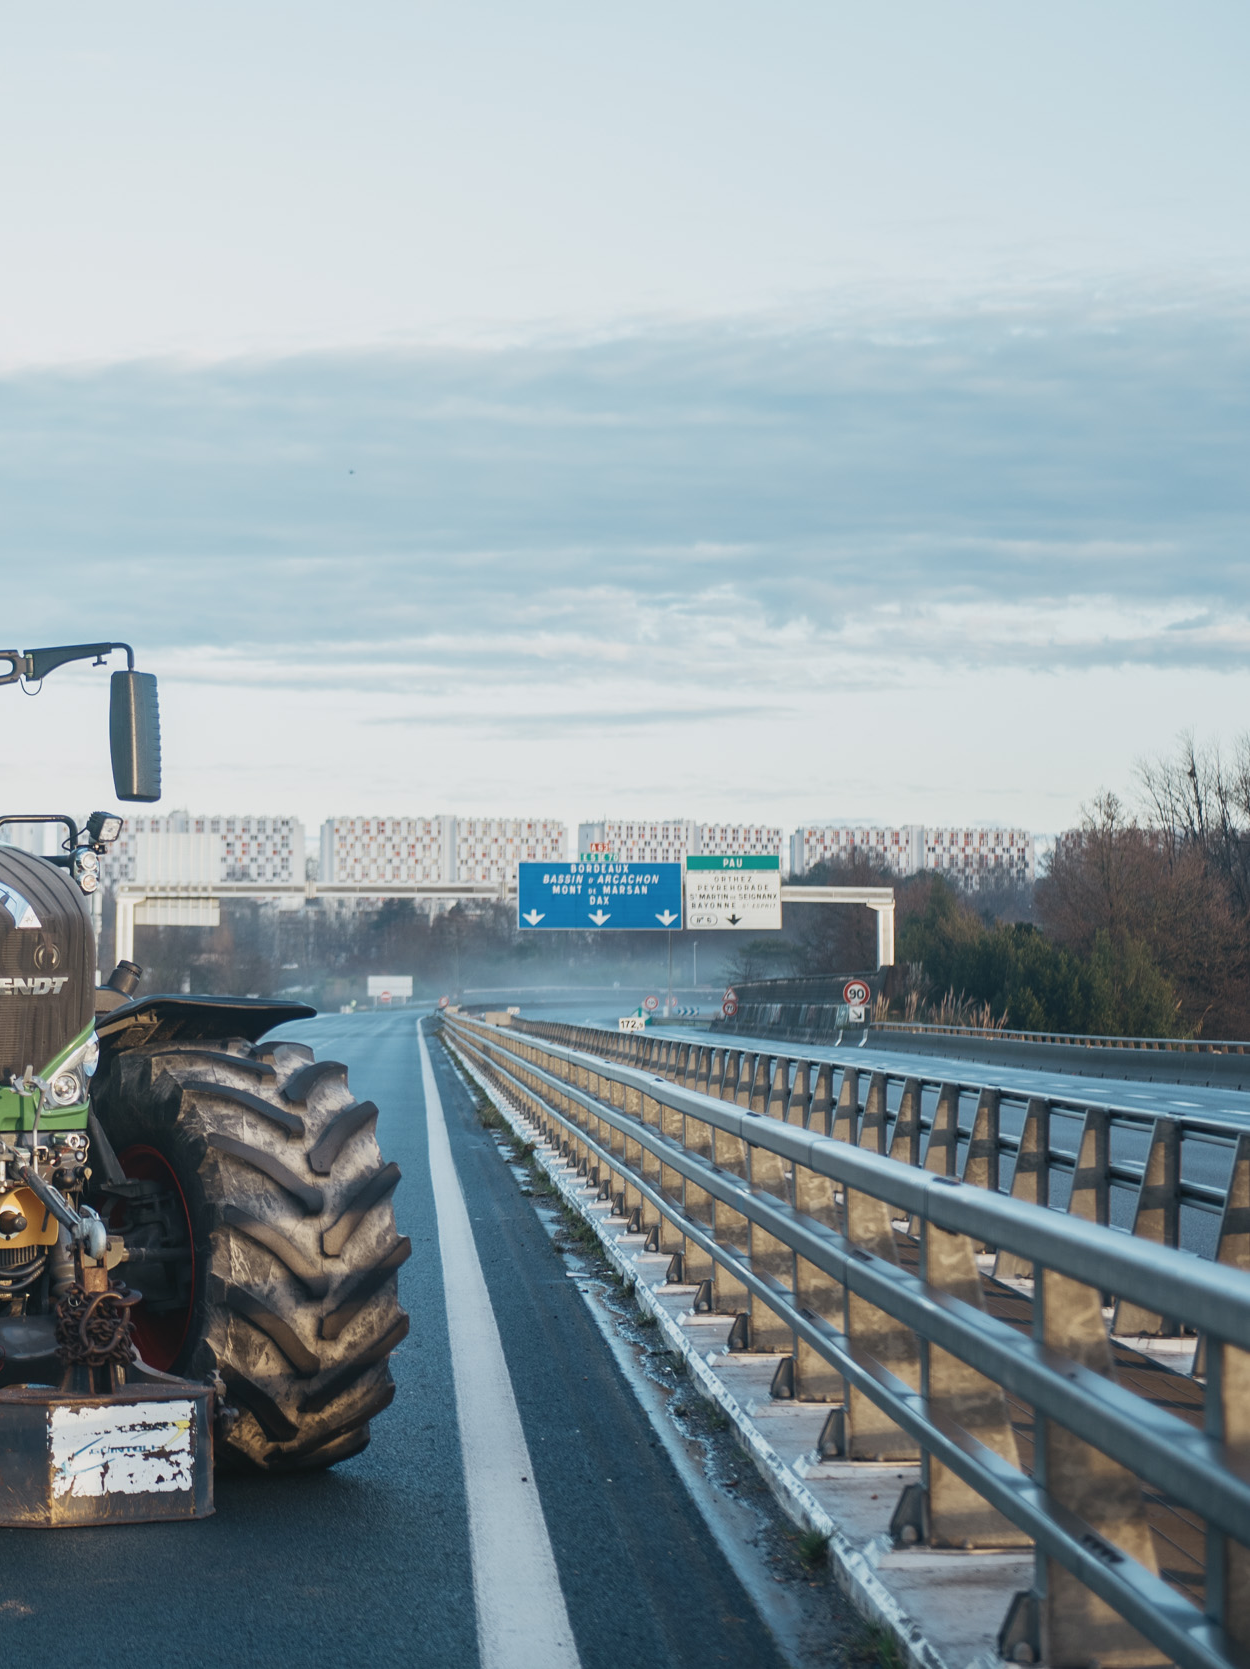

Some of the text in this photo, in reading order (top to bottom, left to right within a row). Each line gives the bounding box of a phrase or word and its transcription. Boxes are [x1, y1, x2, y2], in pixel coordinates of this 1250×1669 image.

[723, 858, 743, 868] PAU
[570, 864, 629, 873] BORDEAUX
[542, 874, 583, 884] BASSIN
[552, 885, 582, 895] MONT
[603, 885, 648, 895] MARSAN
[589, 896, 610, 905] DAX
[849, 988, 865, 999] 90
